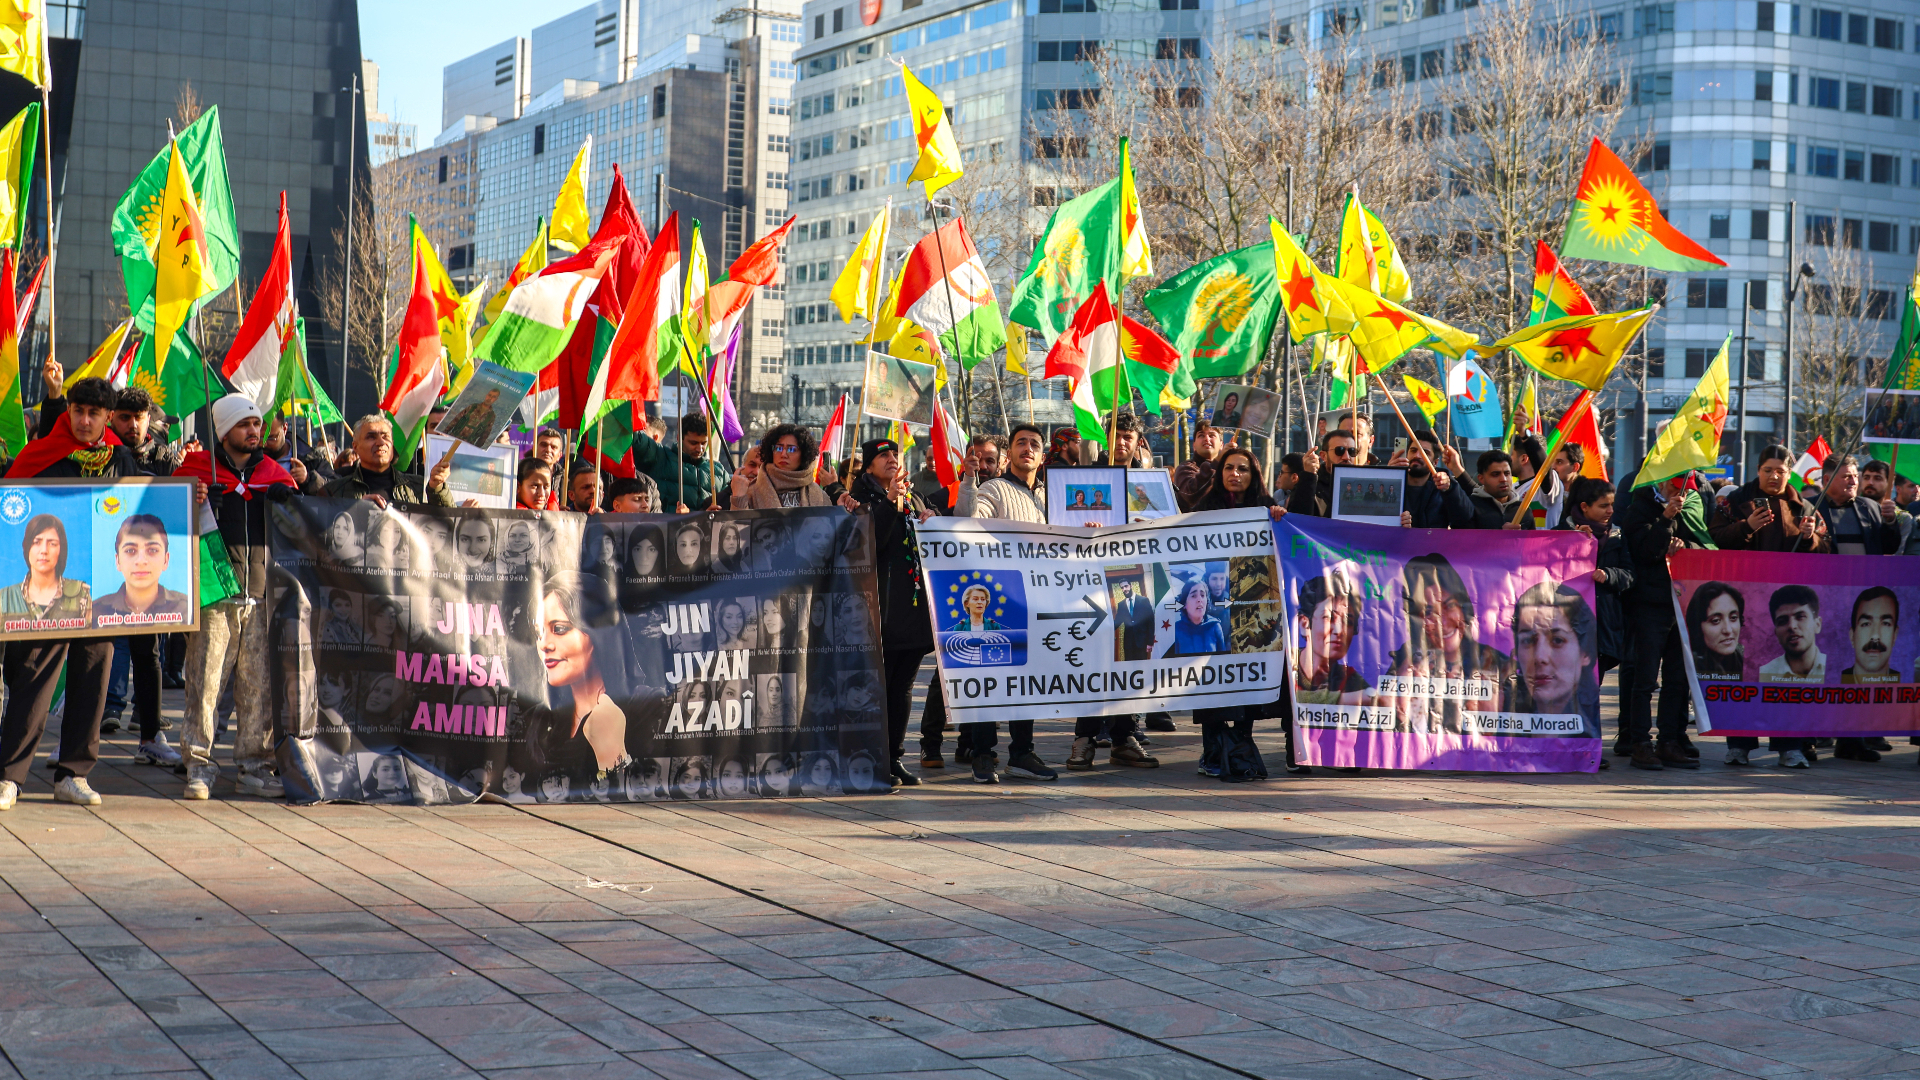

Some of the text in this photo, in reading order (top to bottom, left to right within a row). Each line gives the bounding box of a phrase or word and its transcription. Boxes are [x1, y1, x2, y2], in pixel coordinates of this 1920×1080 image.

[920, 530, 1274, 559] STOP THE MASS MURDER ON KURDS!
[1290, 534, 1388, 566] Freedom
[1030, 569, 1102, 591] in Syria
[1364, 578, 1393, 601] for
[32, 618, 57, 630] LEYLA
[60, 618, 86, 629] QASIM
[155, 613, 182, 622] AMARA
[437, 602, 505, 636] JINA
[661, 602, 710, 636] JIN
[396, 650, 509, 687] MAHSA
[666, 648, 750, 684] JIYAN
[946, 662, 1267, 699] TOP FINANCING JIHADISTS!
[1381, 678, 1488, 697] #Zeynab_Jalalian
[1706, 685, 1758, 702] STOP
[1762, 686, 1870, 704] EXECUTION
[1874, 687, 1894, 704] IN
[410, 702, 506, 736] AMINI
[664, 690, 754, 733] AZADÎ
[1464, 714, 1579, 733] #Warisha_Moradi
[357, 724, 400, 734] Negin Salehi
